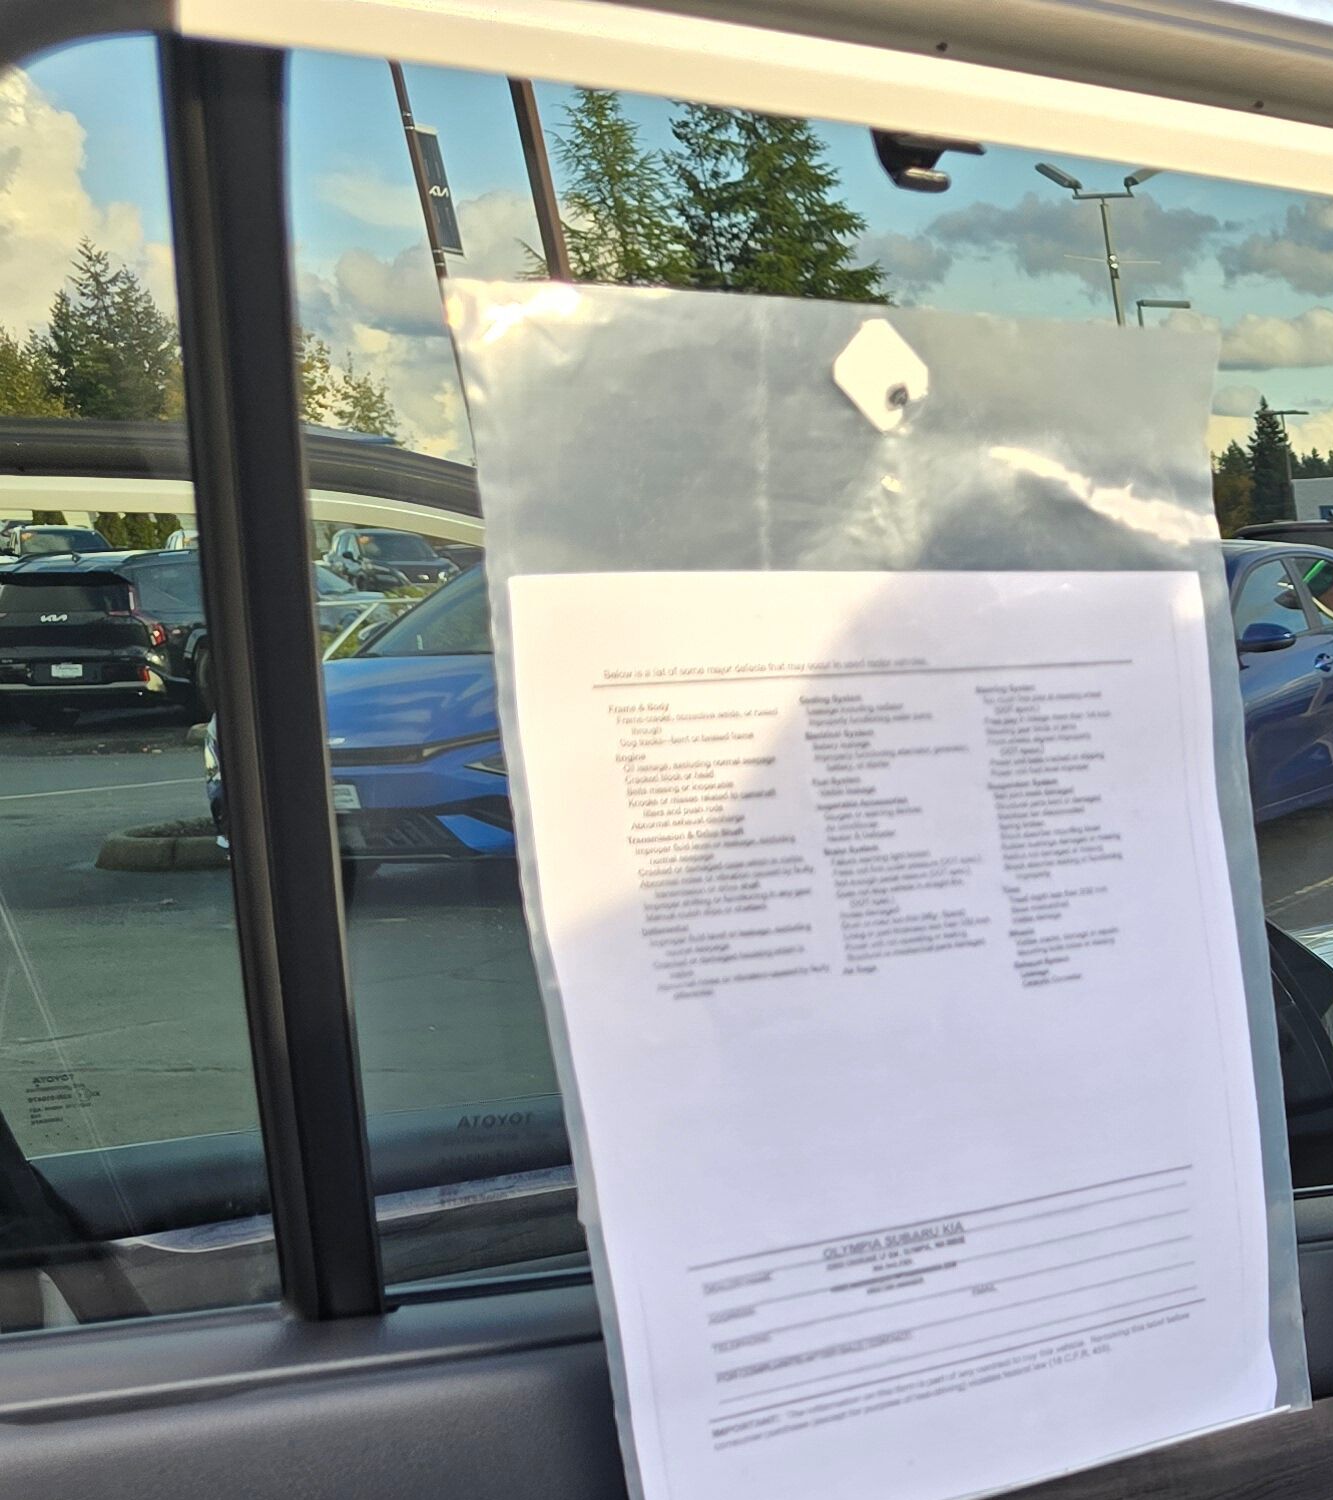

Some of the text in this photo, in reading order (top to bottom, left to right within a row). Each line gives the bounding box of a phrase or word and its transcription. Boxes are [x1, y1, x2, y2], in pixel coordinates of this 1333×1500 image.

[823, 1238, 882, 1260] OLYMPIA
[885, 1226, 939, 1248] SUBARU
[942, 1221, 964, 1235] KIA
